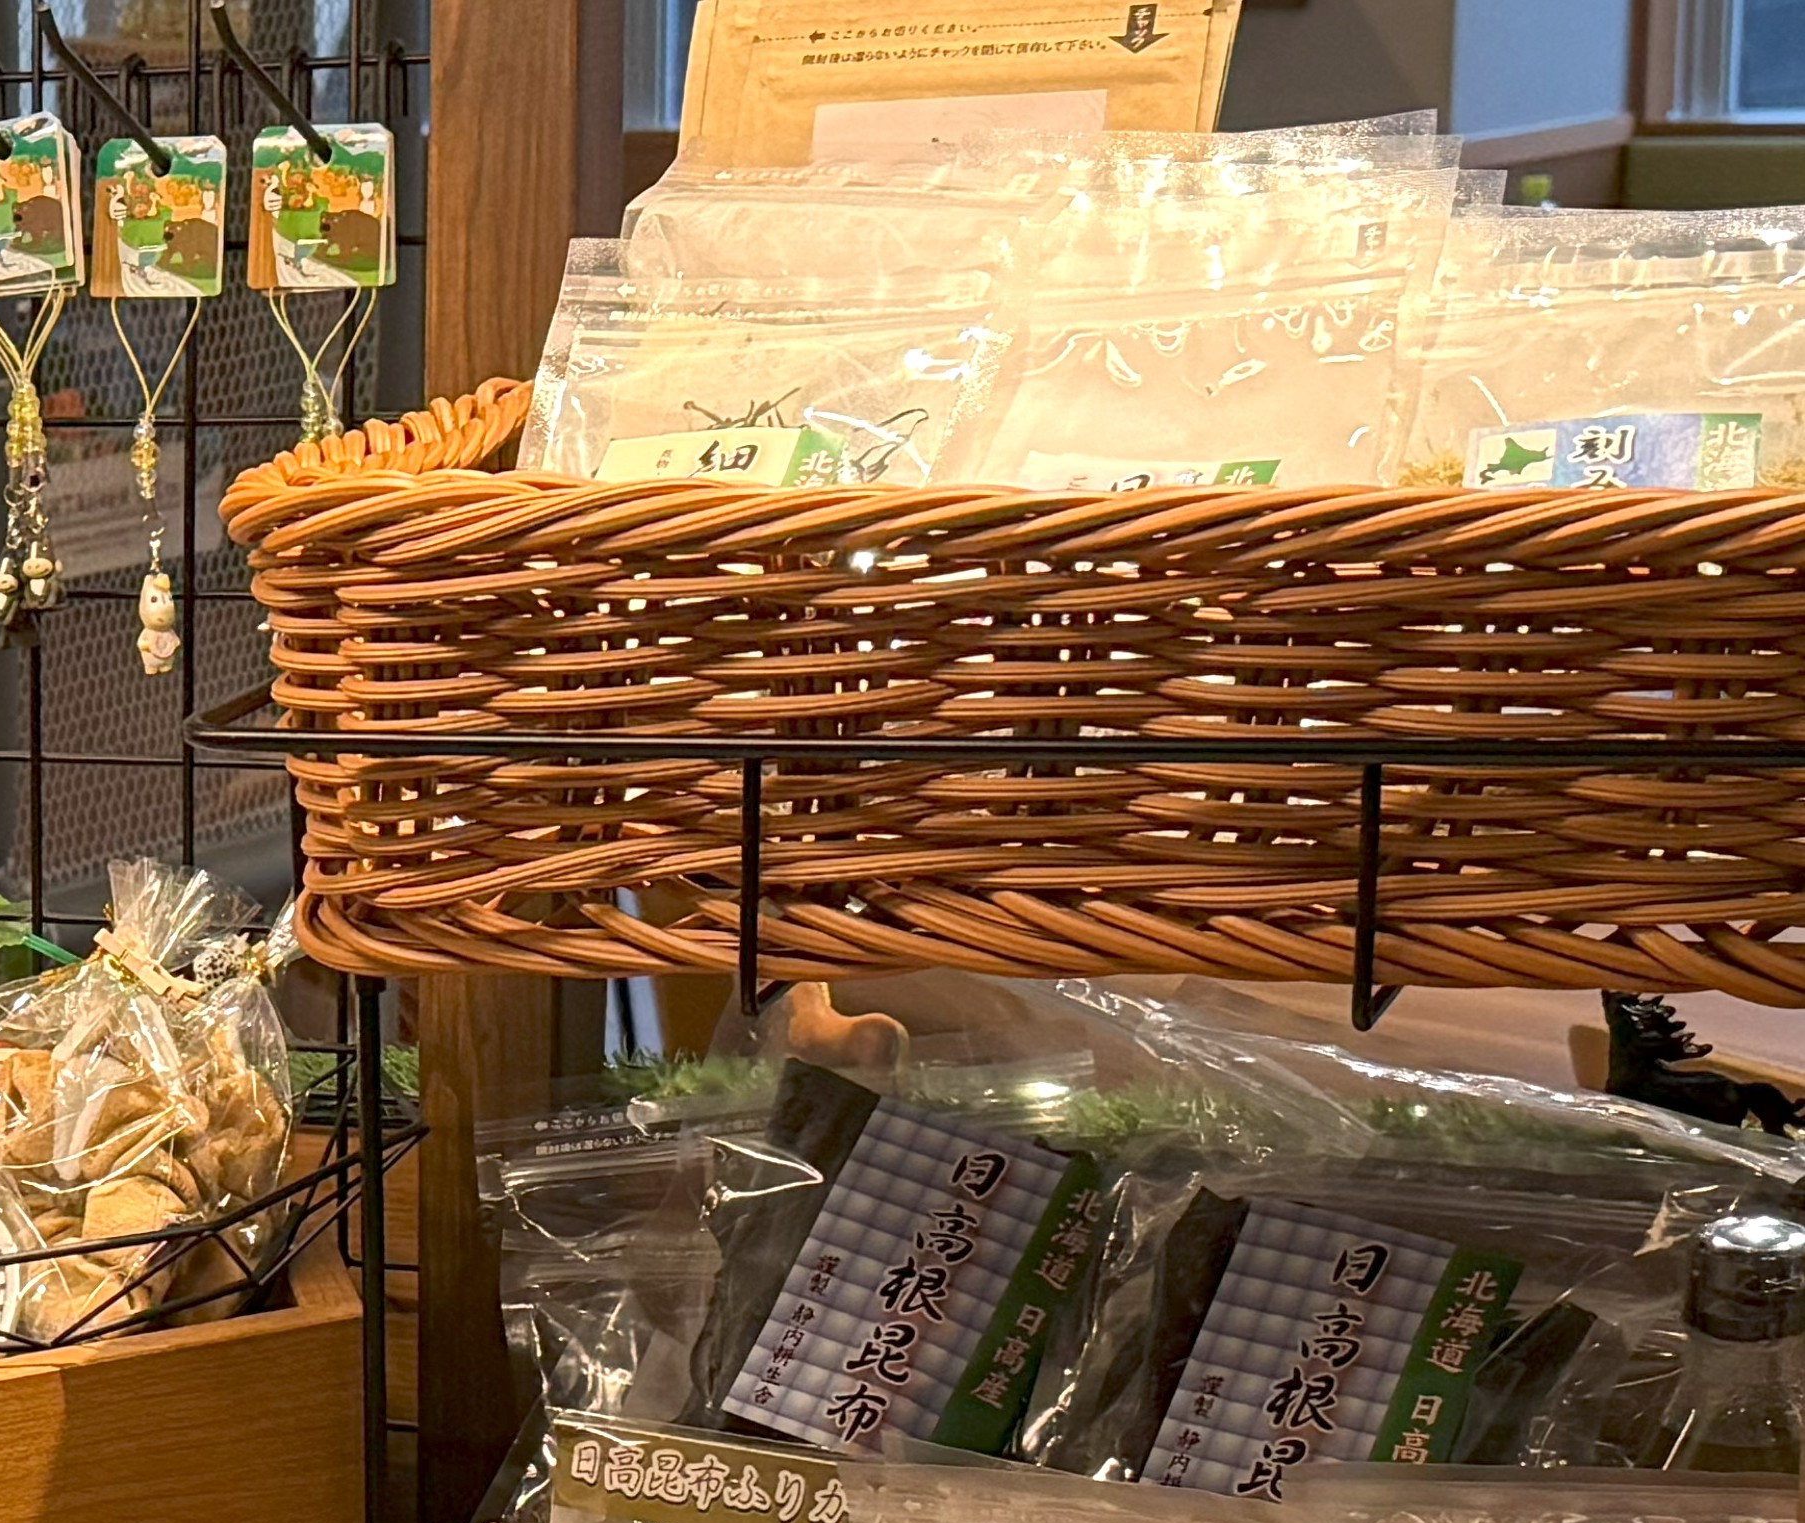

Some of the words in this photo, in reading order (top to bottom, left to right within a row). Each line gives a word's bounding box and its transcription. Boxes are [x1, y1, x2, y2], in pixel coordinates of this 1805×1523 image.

[1031, 1186, 1104, 1292] 北海道
[824, 1152, 1008, 1443] 日高根昆布
[1426, 1269, 1501, 1375] 北海道
[969, 1303, 1048, 1410] 日高産
[1391, 1394, 1444, 1465] 日高
